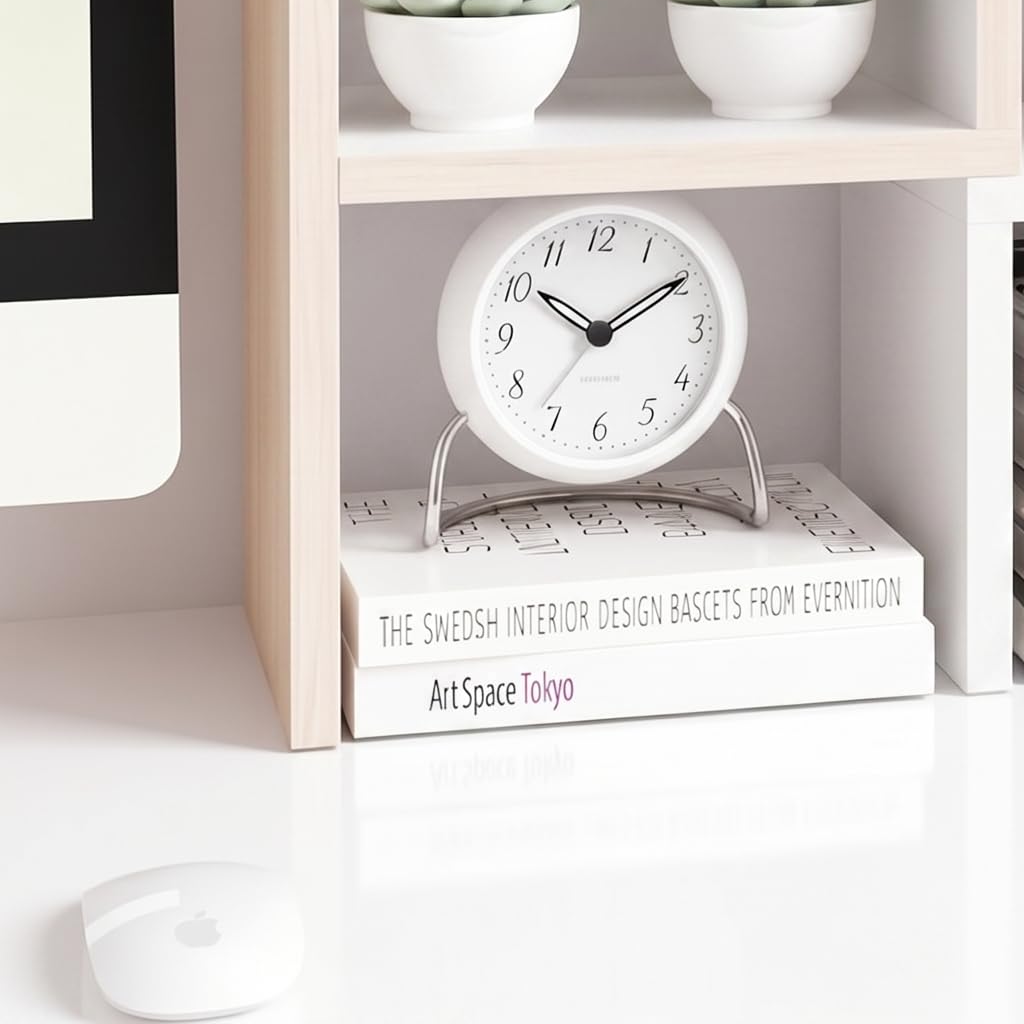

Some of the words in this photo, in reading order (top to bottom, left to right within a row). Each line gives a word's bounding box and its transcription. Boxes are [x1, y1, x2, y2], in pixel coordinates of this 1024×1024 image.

[543, 239, 566, 268] 11
[588, 225, 616, 253] 12
[642, 237, 652, 263] 1
[505, 272, 532, 302] 10
[673, 270, 689, 295] 2
[494, 323, 513, 355] 9
[688, 314, 704, 344] 3
[508, 369, 524, 399] 8
[674, 364, 690, 391] 4
[547, 406, 562, 431] 7
[638, 398, 657, 425] 5
[592, 411, 608, 442] 6
[379, 613, 413, 647] THE
[423, 607, 498, 645] SWEDSH
[507, 600, 589, 638] INTERIOR
[598, 594, 662, 630] DESIGN
[750, 585, 795, 618] FROM
[804, 576, 901, 614] EVERNITION
[429, 679, 459, 711] Art
[462, 676, 516, 715] Space
[521, 671, 574, 710] Tokyo
